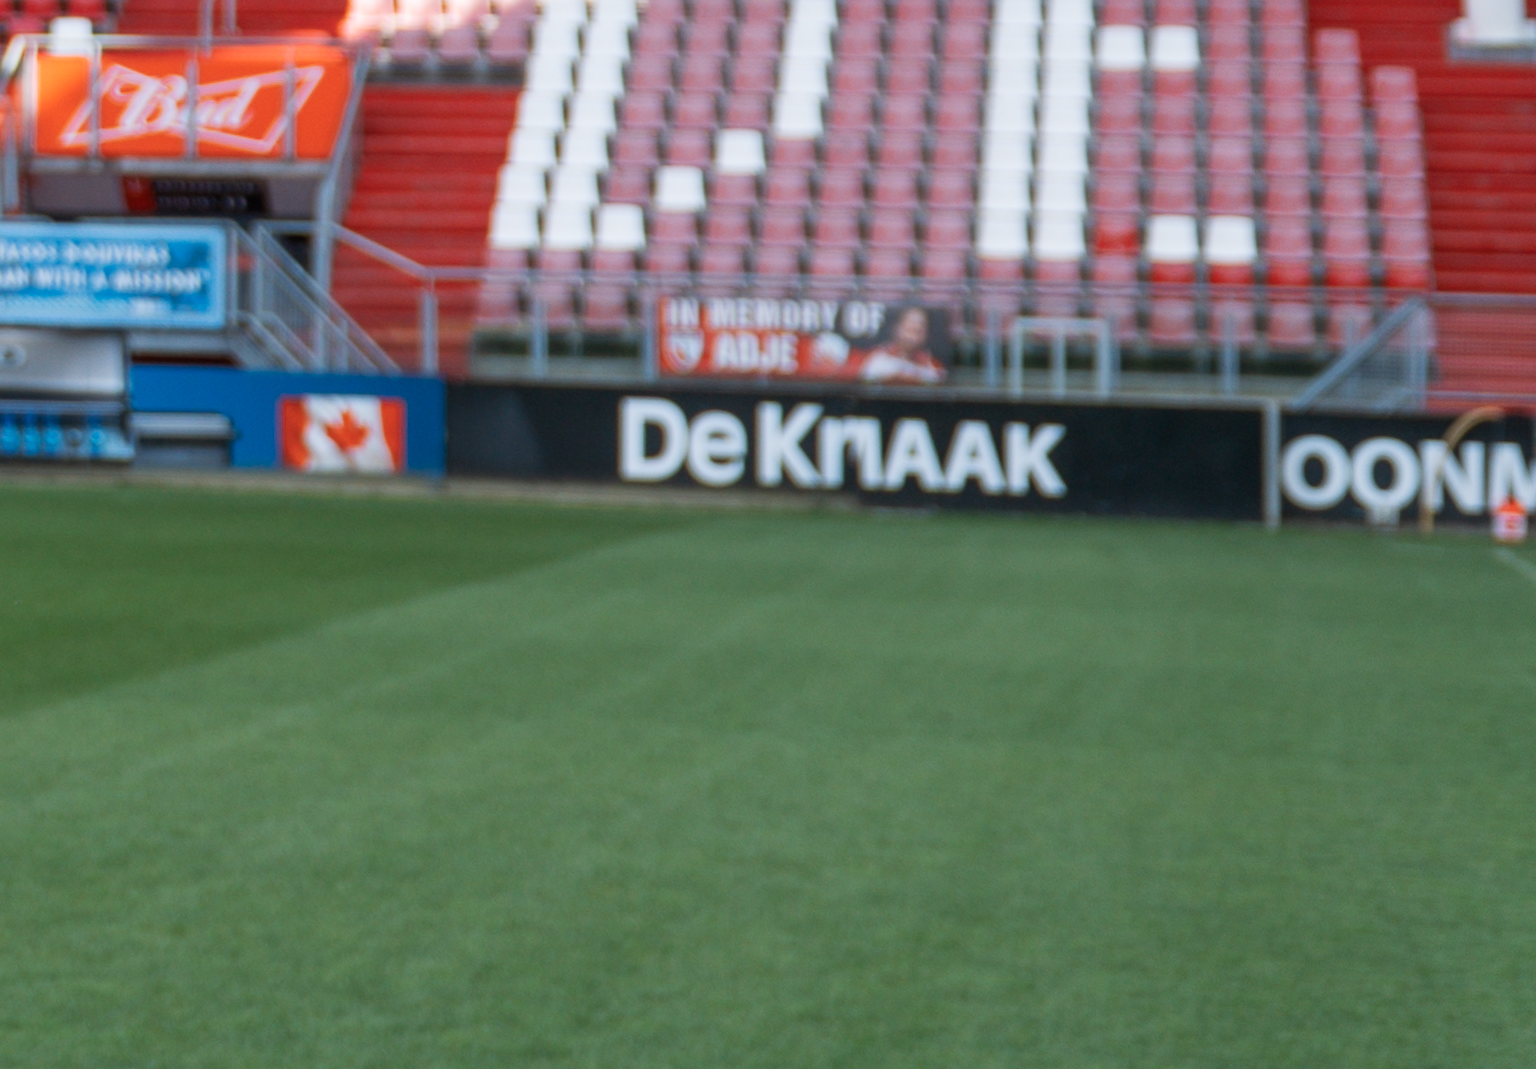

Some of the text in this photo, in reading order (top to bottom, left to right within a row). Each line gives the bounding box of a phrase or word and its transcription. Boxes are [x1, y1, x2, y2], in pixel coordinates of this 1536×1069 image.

[110, 74, 253, 130] Bud
[668, 298, 886, 336] IN MEMORY OF
[712, 333, 798, 371] ADJE
[617, 395, 748, 488] De
